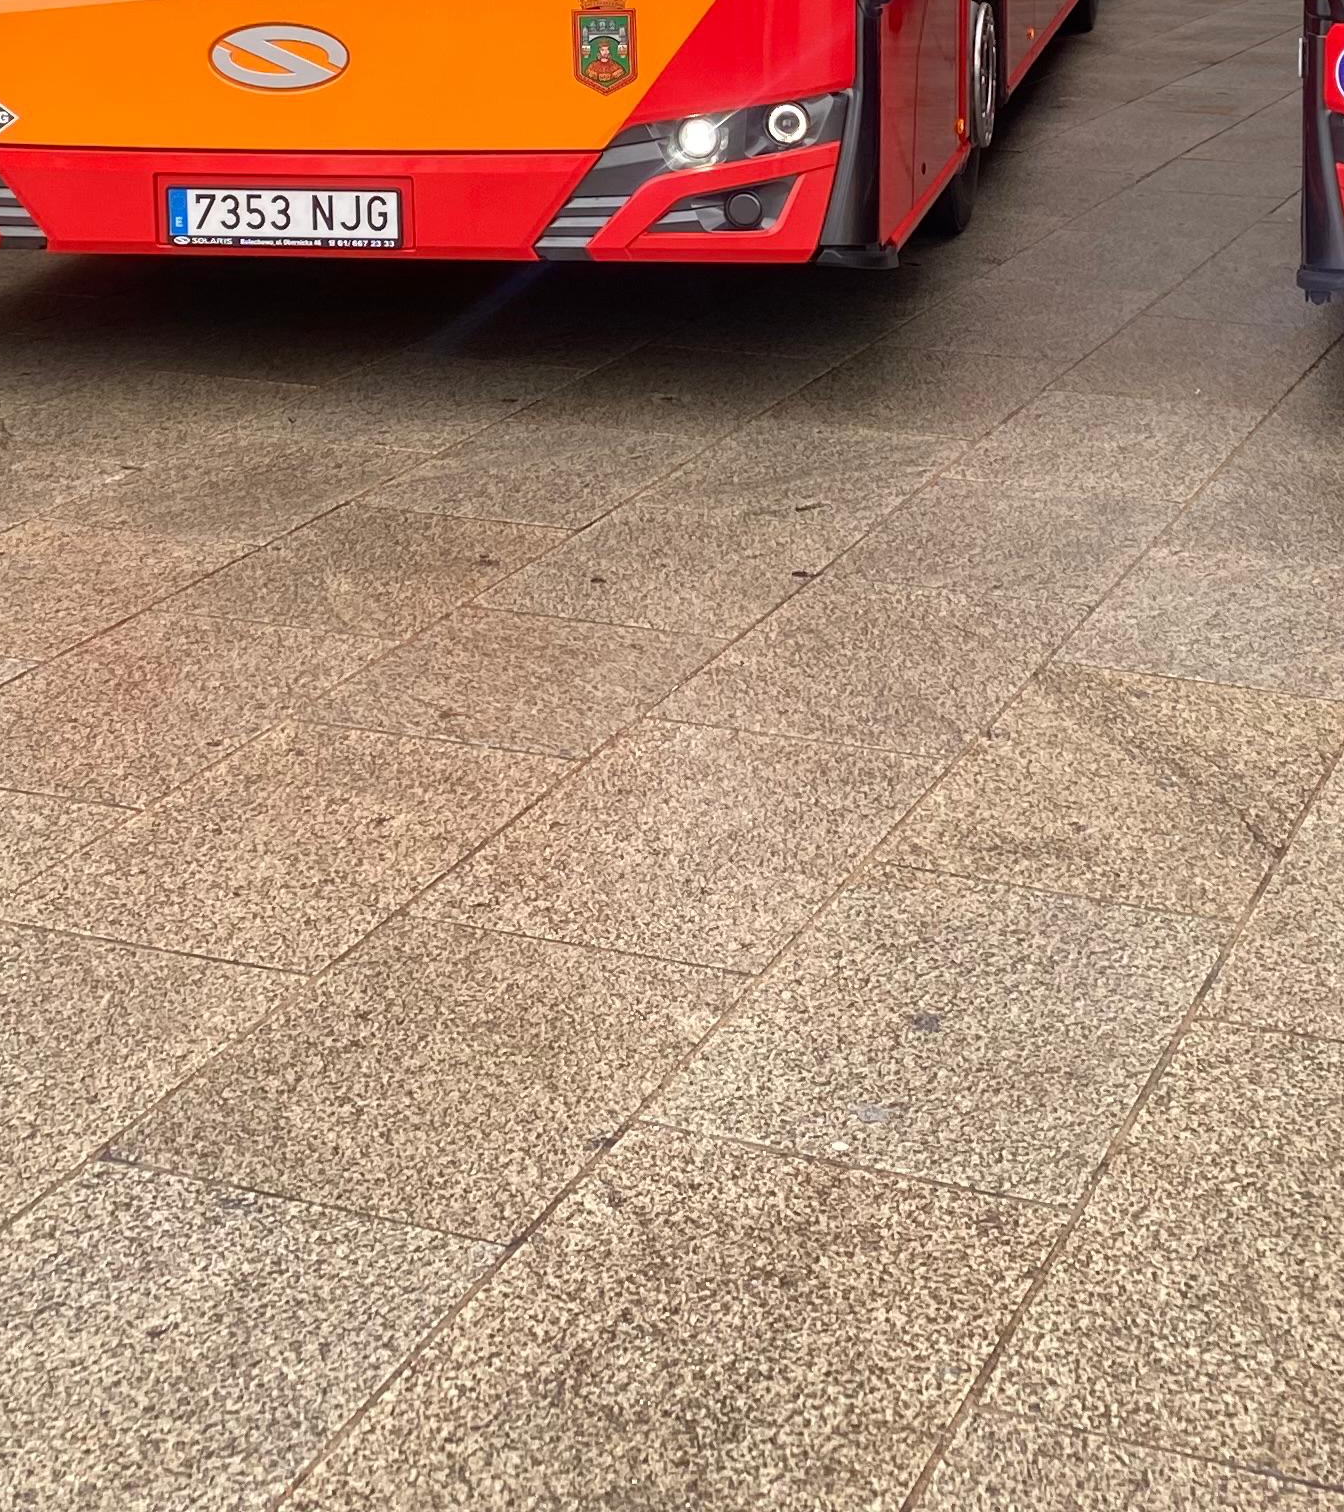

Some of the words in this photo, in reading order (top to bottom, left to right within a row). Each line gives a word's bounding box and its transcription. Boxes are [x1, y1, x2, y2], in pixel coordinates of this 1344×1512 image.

[194, 194, 291, 231] 7353
[311, 195, 388, 232] NJG
[191, 237, 233, 245] SOLARIS
